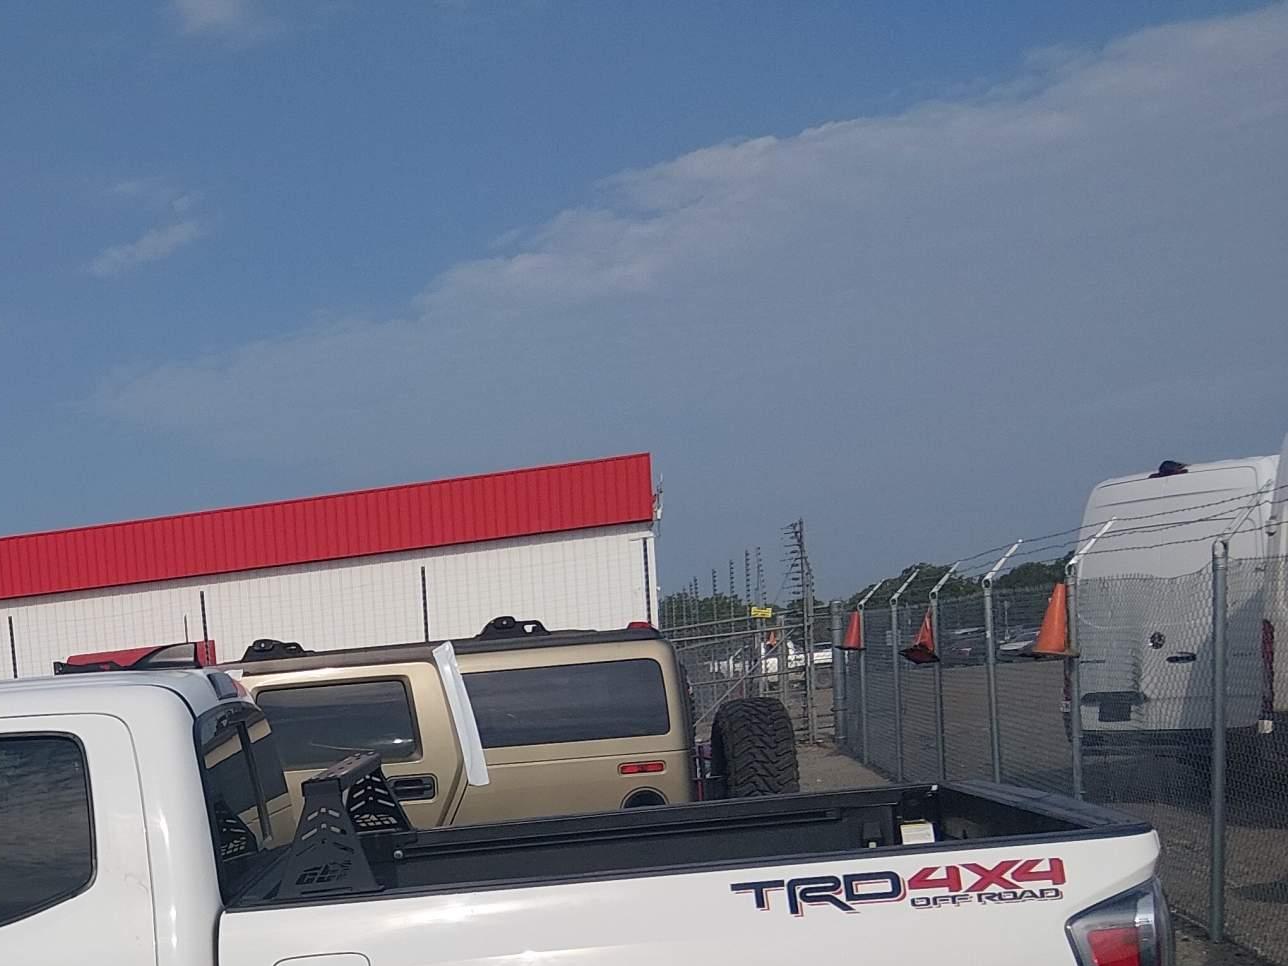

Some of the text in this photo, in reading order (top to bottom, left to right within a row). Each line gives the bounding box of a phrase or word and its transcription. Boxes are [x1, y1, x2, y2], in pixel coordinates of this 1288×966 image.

[730, 870, 907, 917] TRD
[910, 887, 1063, 909] OFF ROAD
